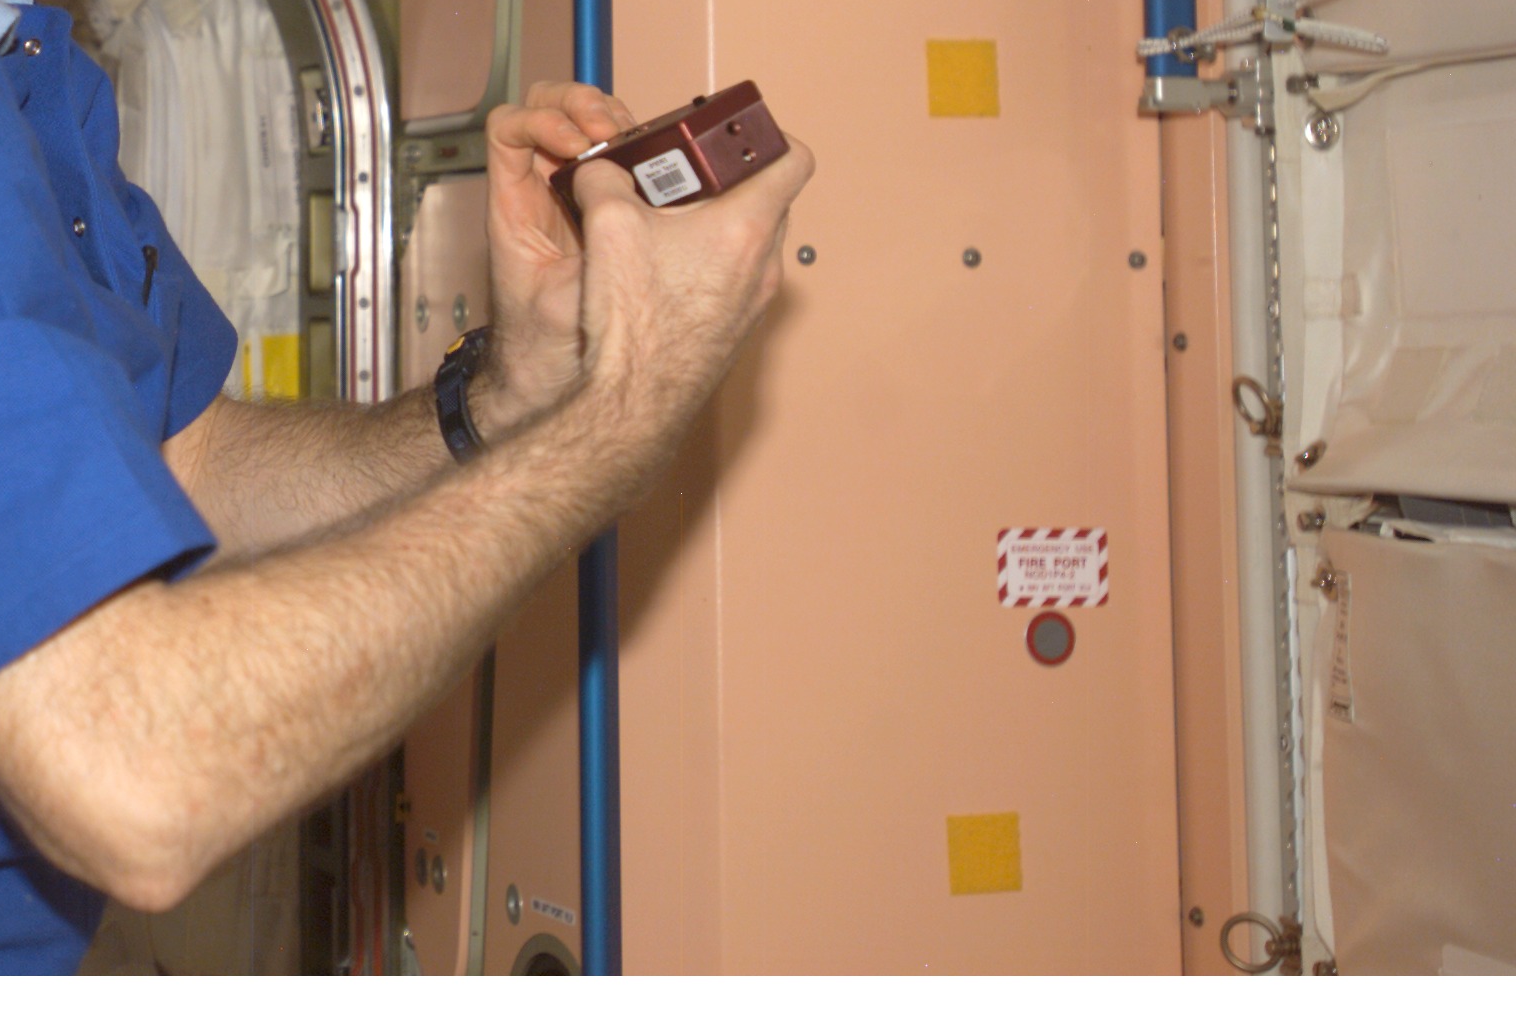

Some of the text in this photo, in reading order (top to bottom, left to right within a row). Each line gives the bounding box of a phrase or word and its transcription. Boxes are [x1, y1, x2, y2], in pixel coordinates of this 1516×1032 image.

[1011, 544, 1070, 553] EMERGENCY
[1019, 557, 1088, 568] FIRE PORT
